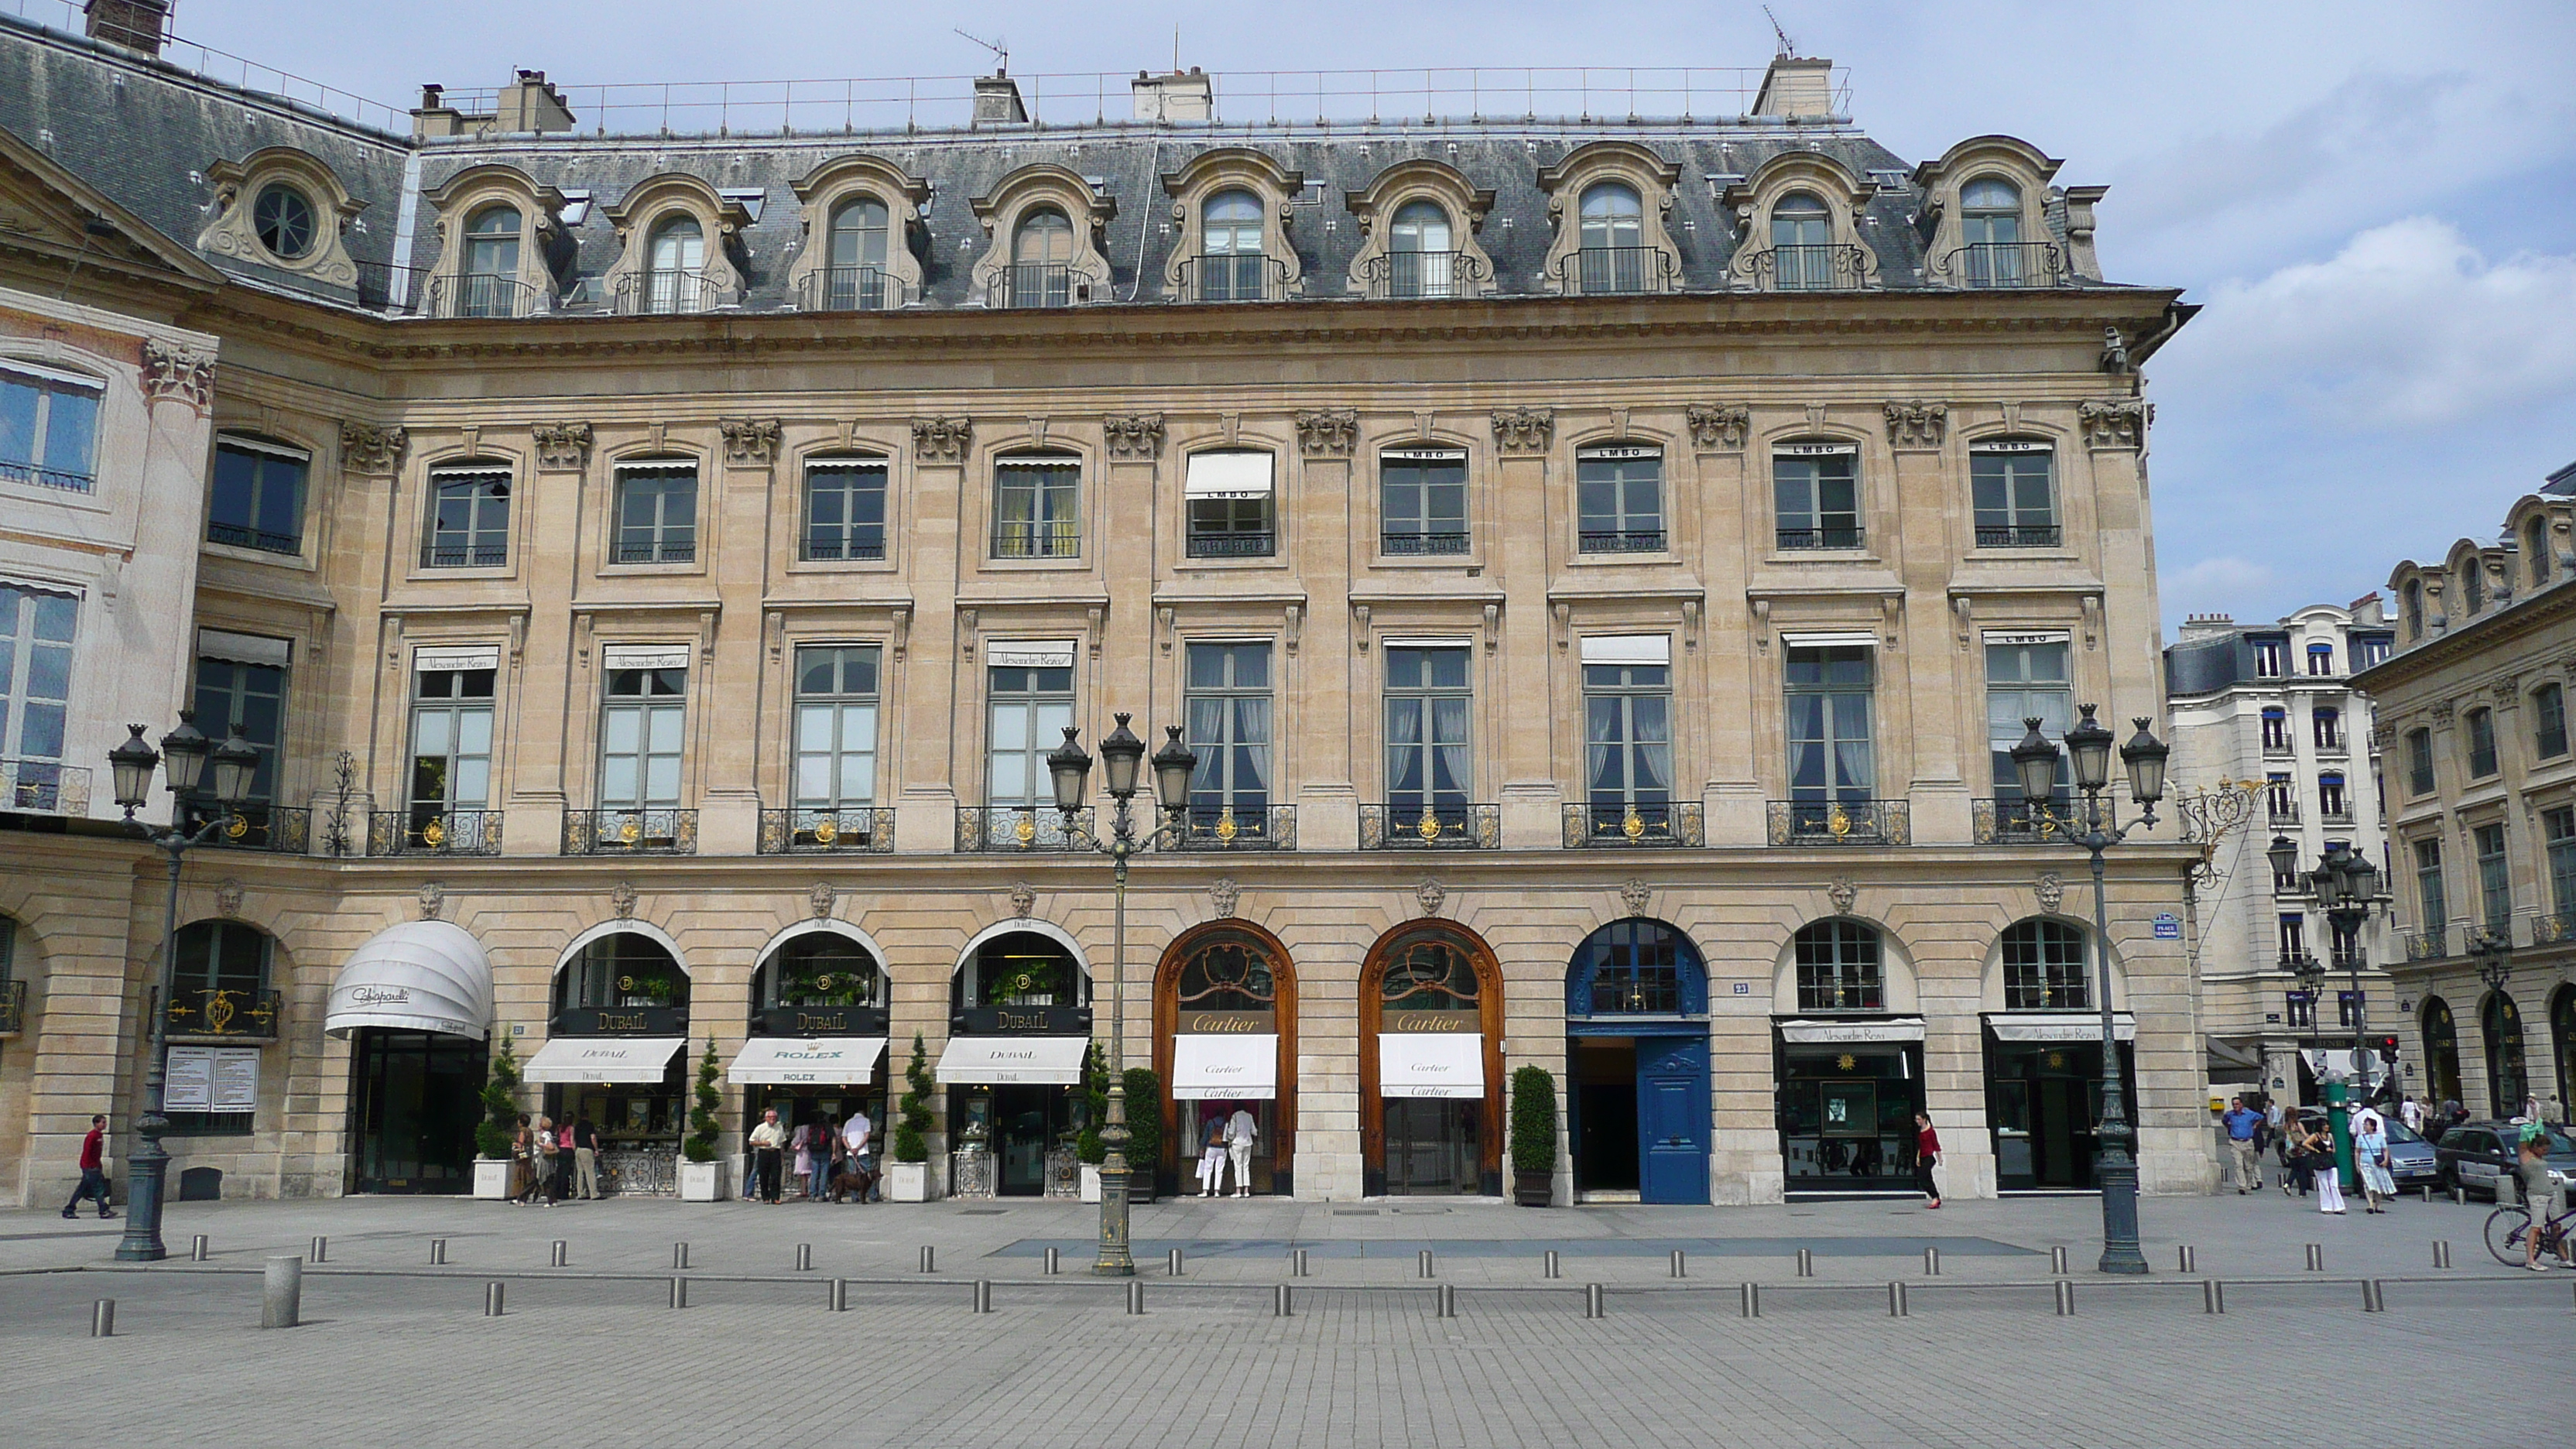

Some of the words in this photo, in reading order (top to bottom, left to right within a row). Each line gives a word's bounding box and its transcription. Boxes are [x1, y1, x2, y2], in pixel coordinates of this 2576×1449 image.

[428, 656, 466, 669] Alexandre
[468, 656, 486, 668] Reza
[616, 655, 655, 666] Alexandre
[657, 655, 677, 666] Reza
[999, 652, 1039, 665] Alexandre
[1041, 653, 1062, 665] Reza
[1735, 985, 1747, 993] 23
[598, 1012, 648, 1030] DUBAIL
[796, 1012, 847, 1030] DUBAIL
[997, 1011, 1049, 1029] DUBAIL
[1193, 1014, 1259, 1032] Cartier
[1397, 1013, 1464, 1031] Cartier
[1823, 1029, 1862, 1040] Alexandre
[1864, 1029, 1885, 1040] Reza
[2033, 1028, 2073, 1039] Alexandre
[2075, 1028, 2095, 1039] Reza
[1205, 1064, 1245, 1074] Cartier
[1411, 1063, 1451, 1072] Cartier
[1204, 1087, 1244, 1098] Cartier
[1411, 1085, 1452, 1096] Cartier
